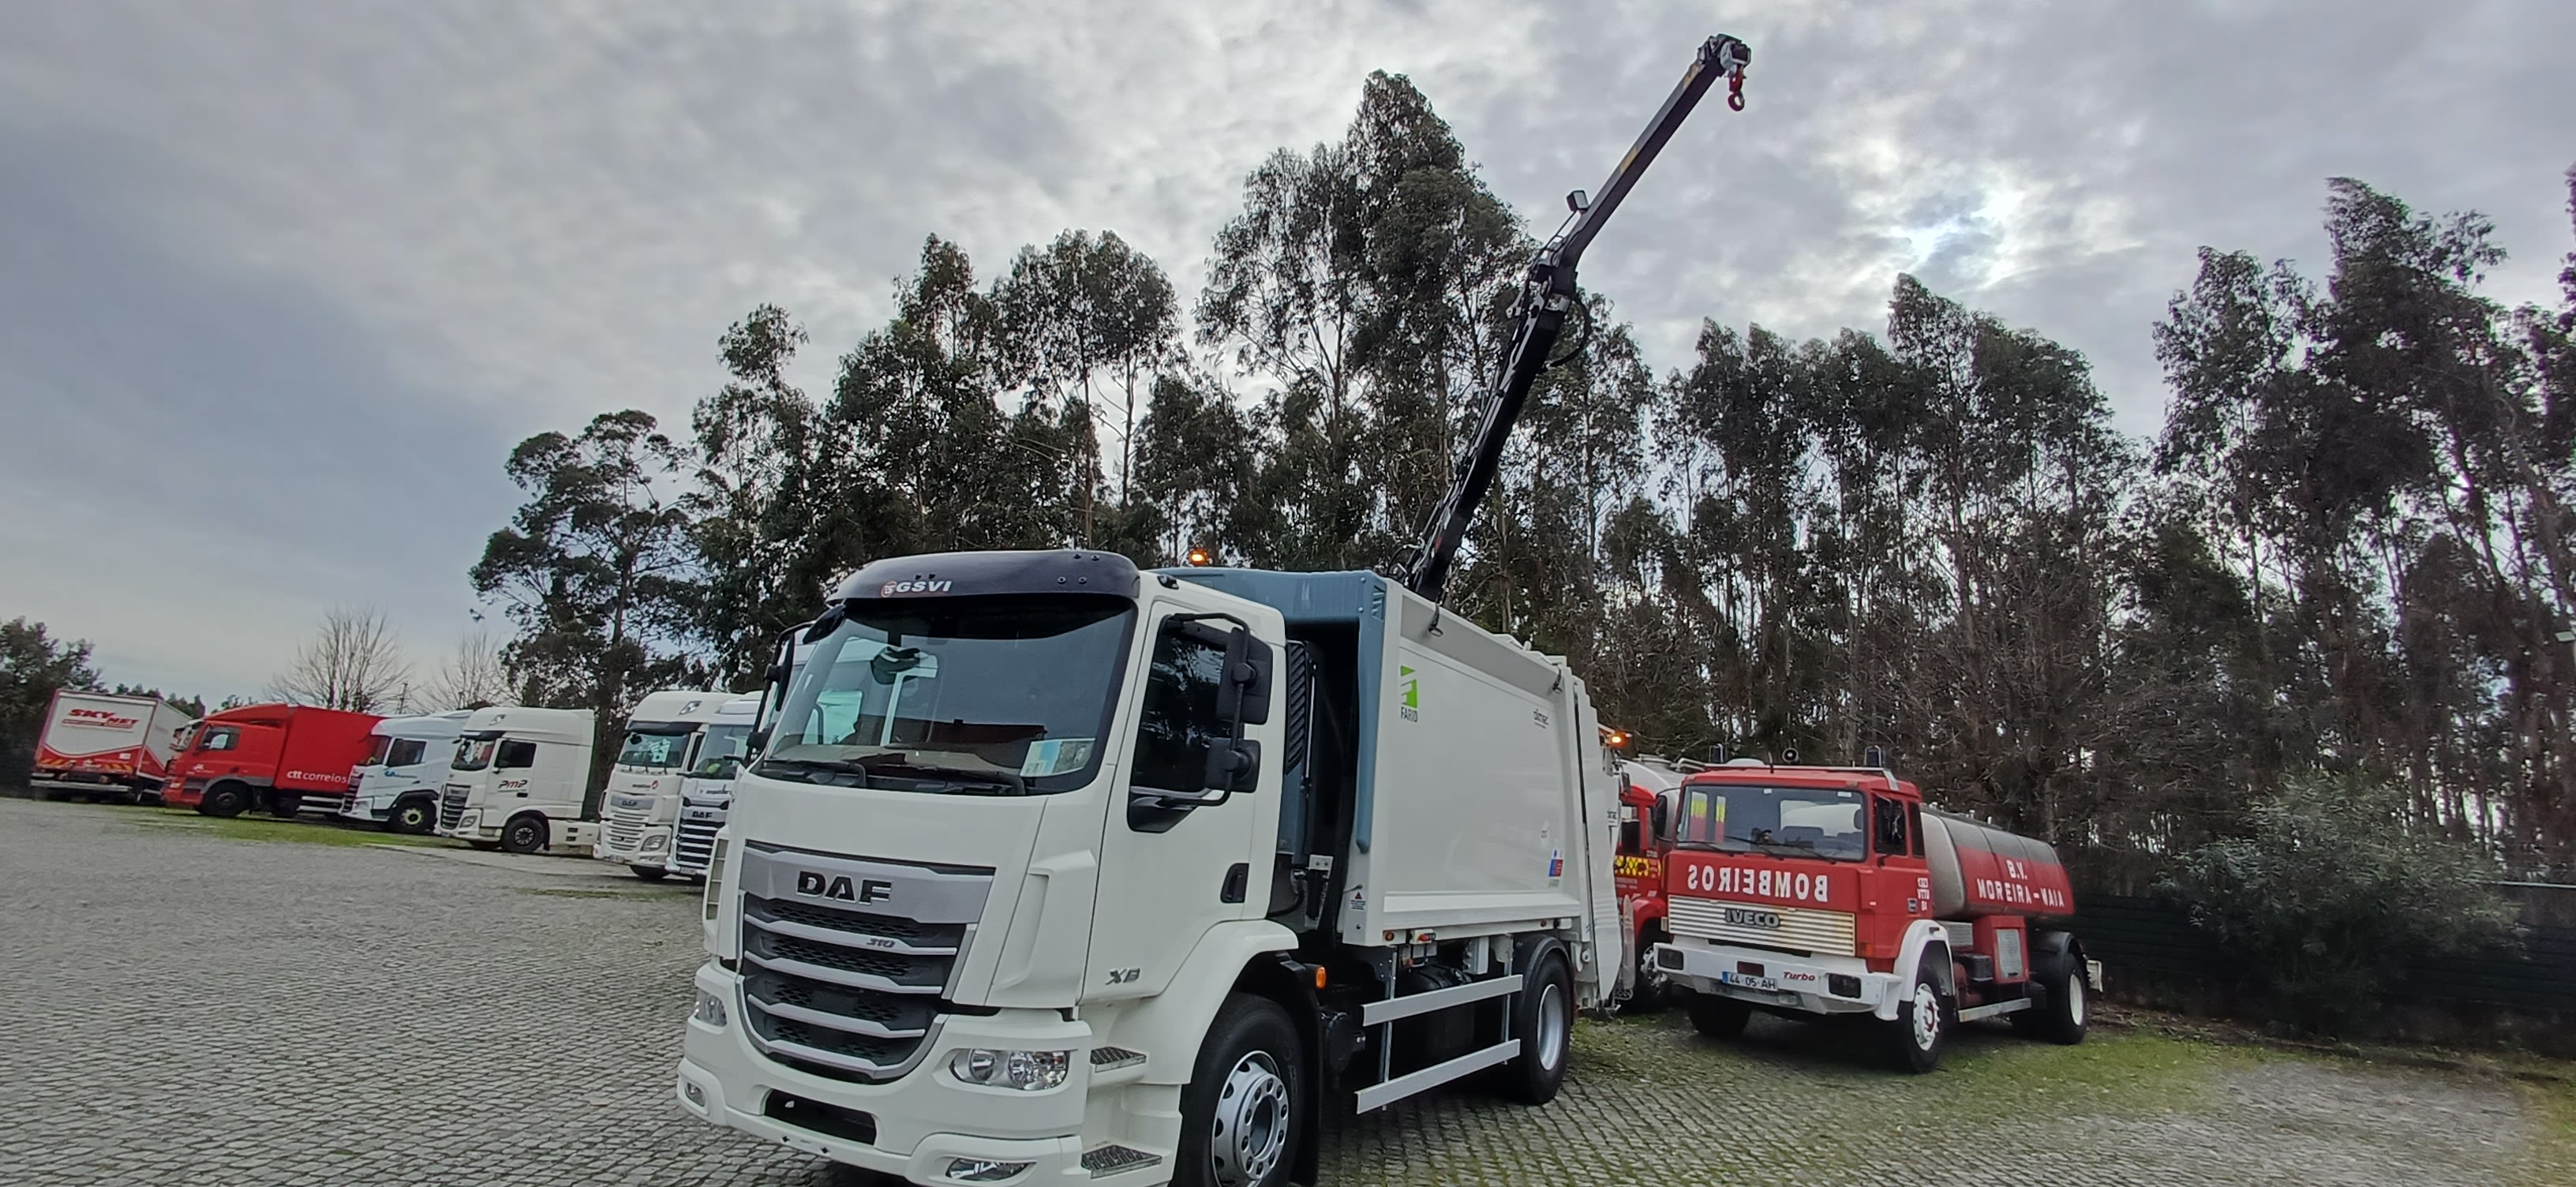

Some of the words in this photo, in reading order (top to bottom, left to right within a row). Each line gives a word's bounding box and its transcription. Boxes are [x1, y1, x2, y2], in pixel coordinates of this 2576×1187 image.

[896, 580, 952, 593] GSVI
[286, 770, 302, 780] ctt
[303, 773, 347, 784] correios
[796, 871, 892, 906] DAF
[1725, 908, 1779, 928] IVECO
[1784, 972, 1815, 981] Turbo
